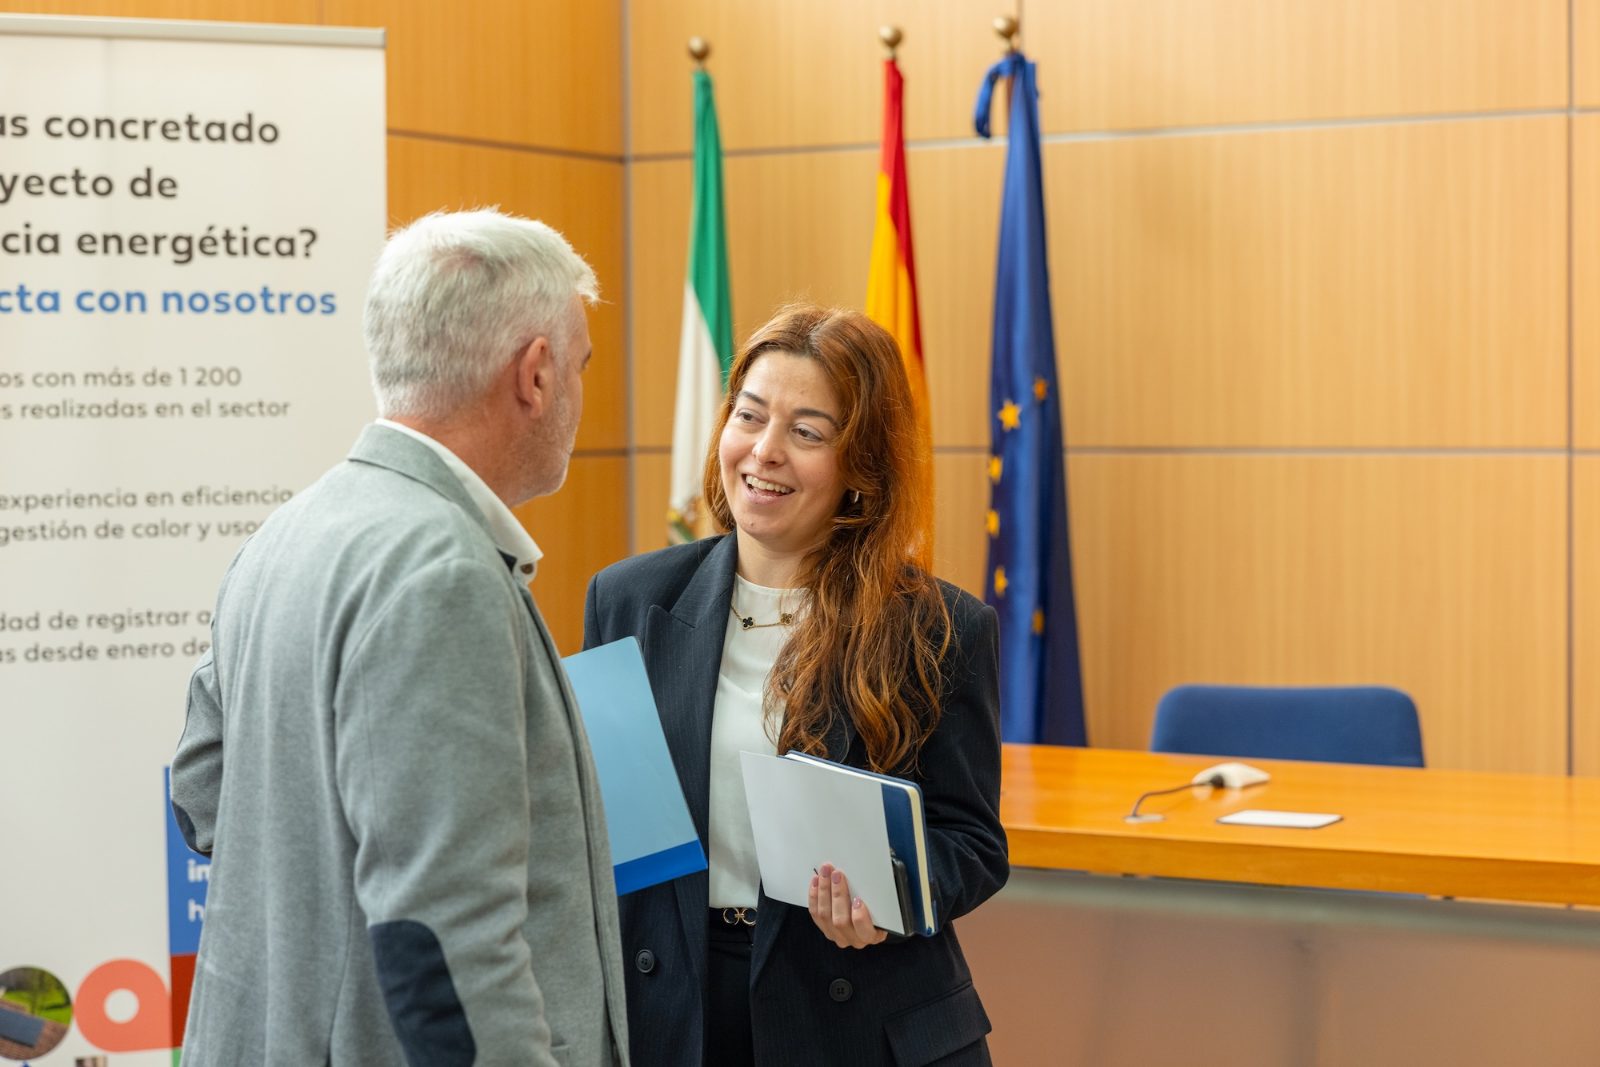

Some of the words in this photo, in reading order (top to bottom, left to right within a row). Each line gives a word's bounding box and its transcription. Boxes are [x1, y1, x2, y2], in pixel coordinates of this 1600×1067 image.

[0, 115, 29, 138] s
[44, 111, 280, 145] concretado
[0, 167, 115, 203] yecto
[129, 167, 179, 199] de
[1, 222, 60, 255] cia
[76, 225, 318, 266] energética?
[0, 283, 61, 315] cta
[75, 289, 148, 315] con
[161, 285, 338, 316] nosotros
[31, 371, 76, 388] con
[83, 366, 136, 388] más
[141, 367, 173, 387] de
[20, 397, 149, 420] realizadas
[154, 402, 185, 418] en
[190, 398, 212, 418] el
[217, 398, 291, 418] sector
[0, 487, 138, 514] experiencia
[145, 491, 175, 508] en
[180, 484, 294, 507] eficiencia
[0, 519, 87, 547] gestión
[94, 519, 126, 540] de
[131, 517, 193, 539] calor
[197, 521, 212, 543] y
[216, 519, 264, 537] uso
[48, 609, 79, 631] de
[86, 606, 190, 635] registrar
[23, 641, 100, 664] desde
[106, 641, 175, 661] enero
